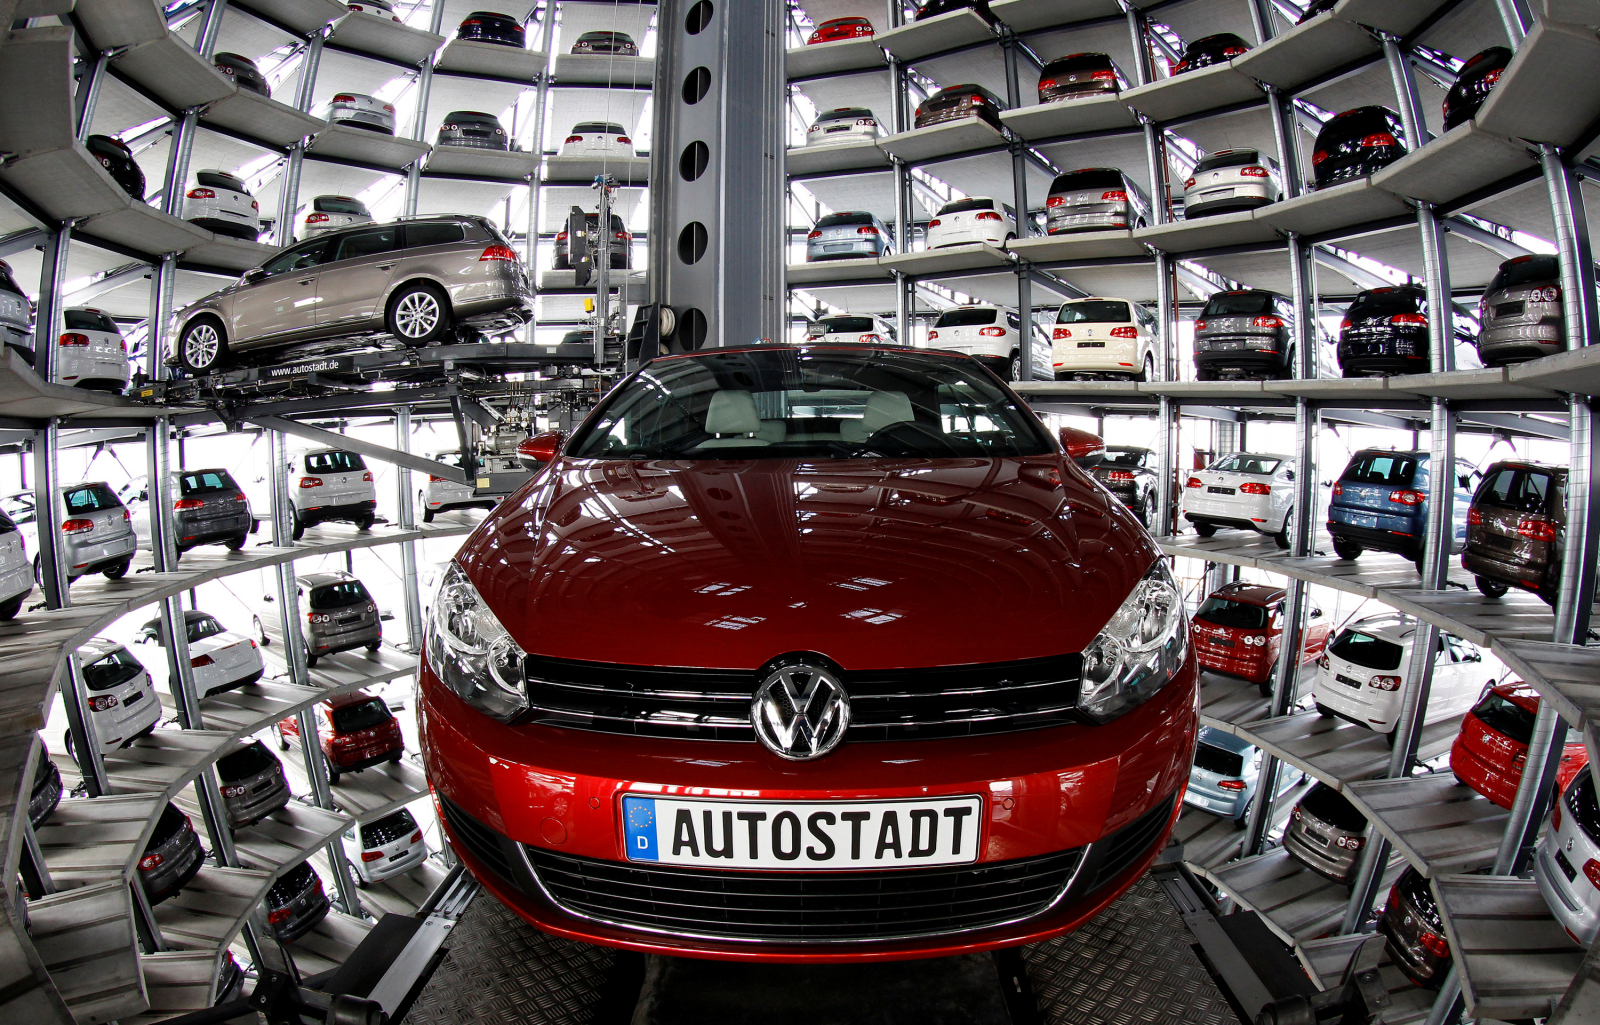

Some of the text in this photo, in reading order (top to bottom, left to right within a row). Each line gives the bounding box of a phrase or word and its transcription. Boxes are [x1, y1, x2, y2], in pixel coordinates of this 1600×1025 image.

[271, 360, 339, 377] www.autostadt.de
[636, 806, 973, 862] D AUTOSTADT
